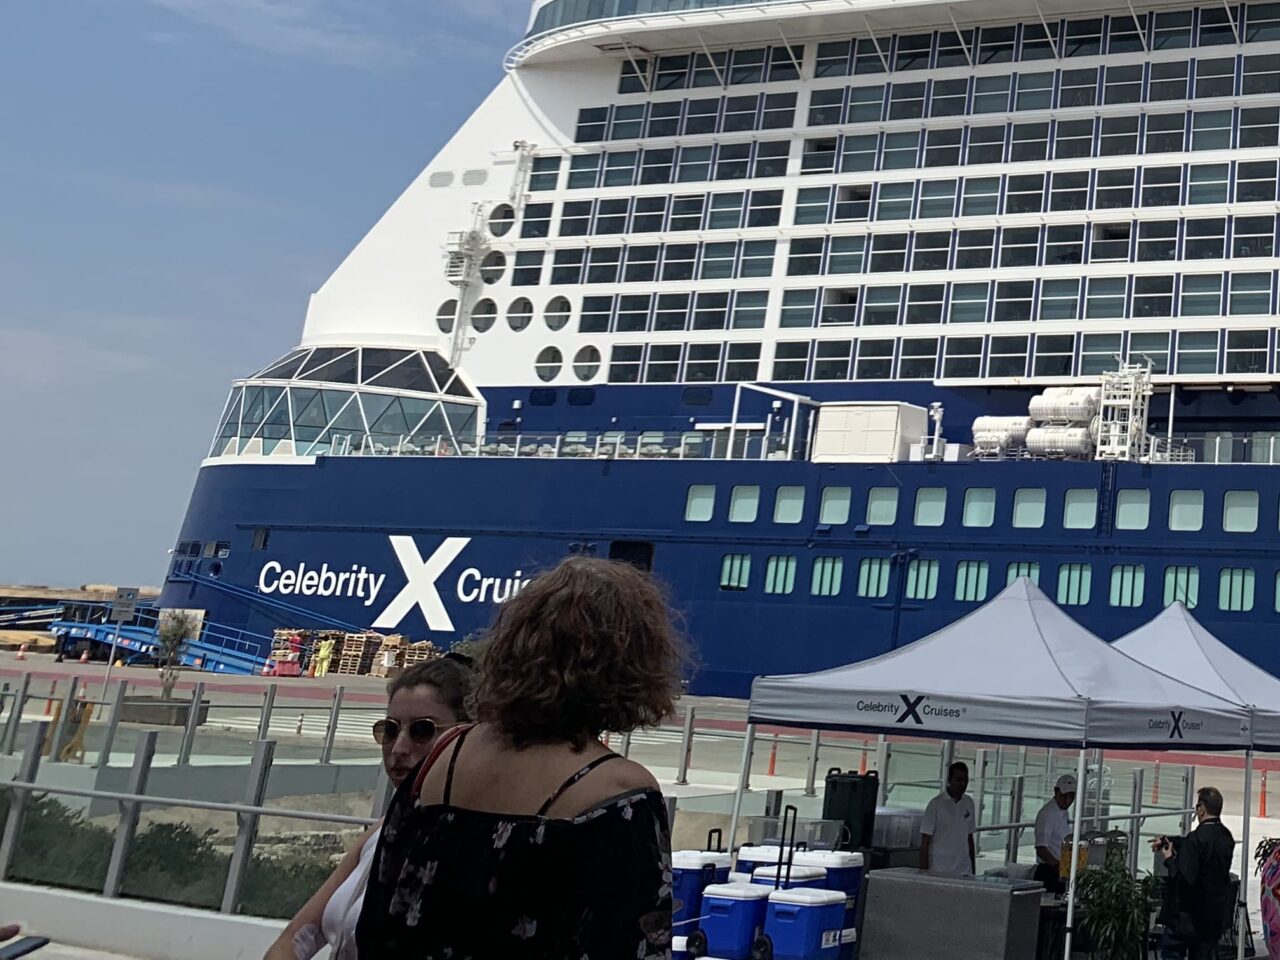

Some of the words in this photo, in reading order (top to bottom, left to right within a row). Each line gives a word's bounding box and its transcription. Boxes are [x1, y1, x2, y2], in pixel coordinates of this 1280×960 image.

[258, 560, 386, 606] Celebrity
[371, 535, 472, 632] X
[856, 700, 900, 716] Celebrity
[896, 694, 926, 725] X
[922, 704, 961, 718] Cruises
[1148, 719, 1171, 731] Celebrity
[1169, 710, 1184, 739] X
